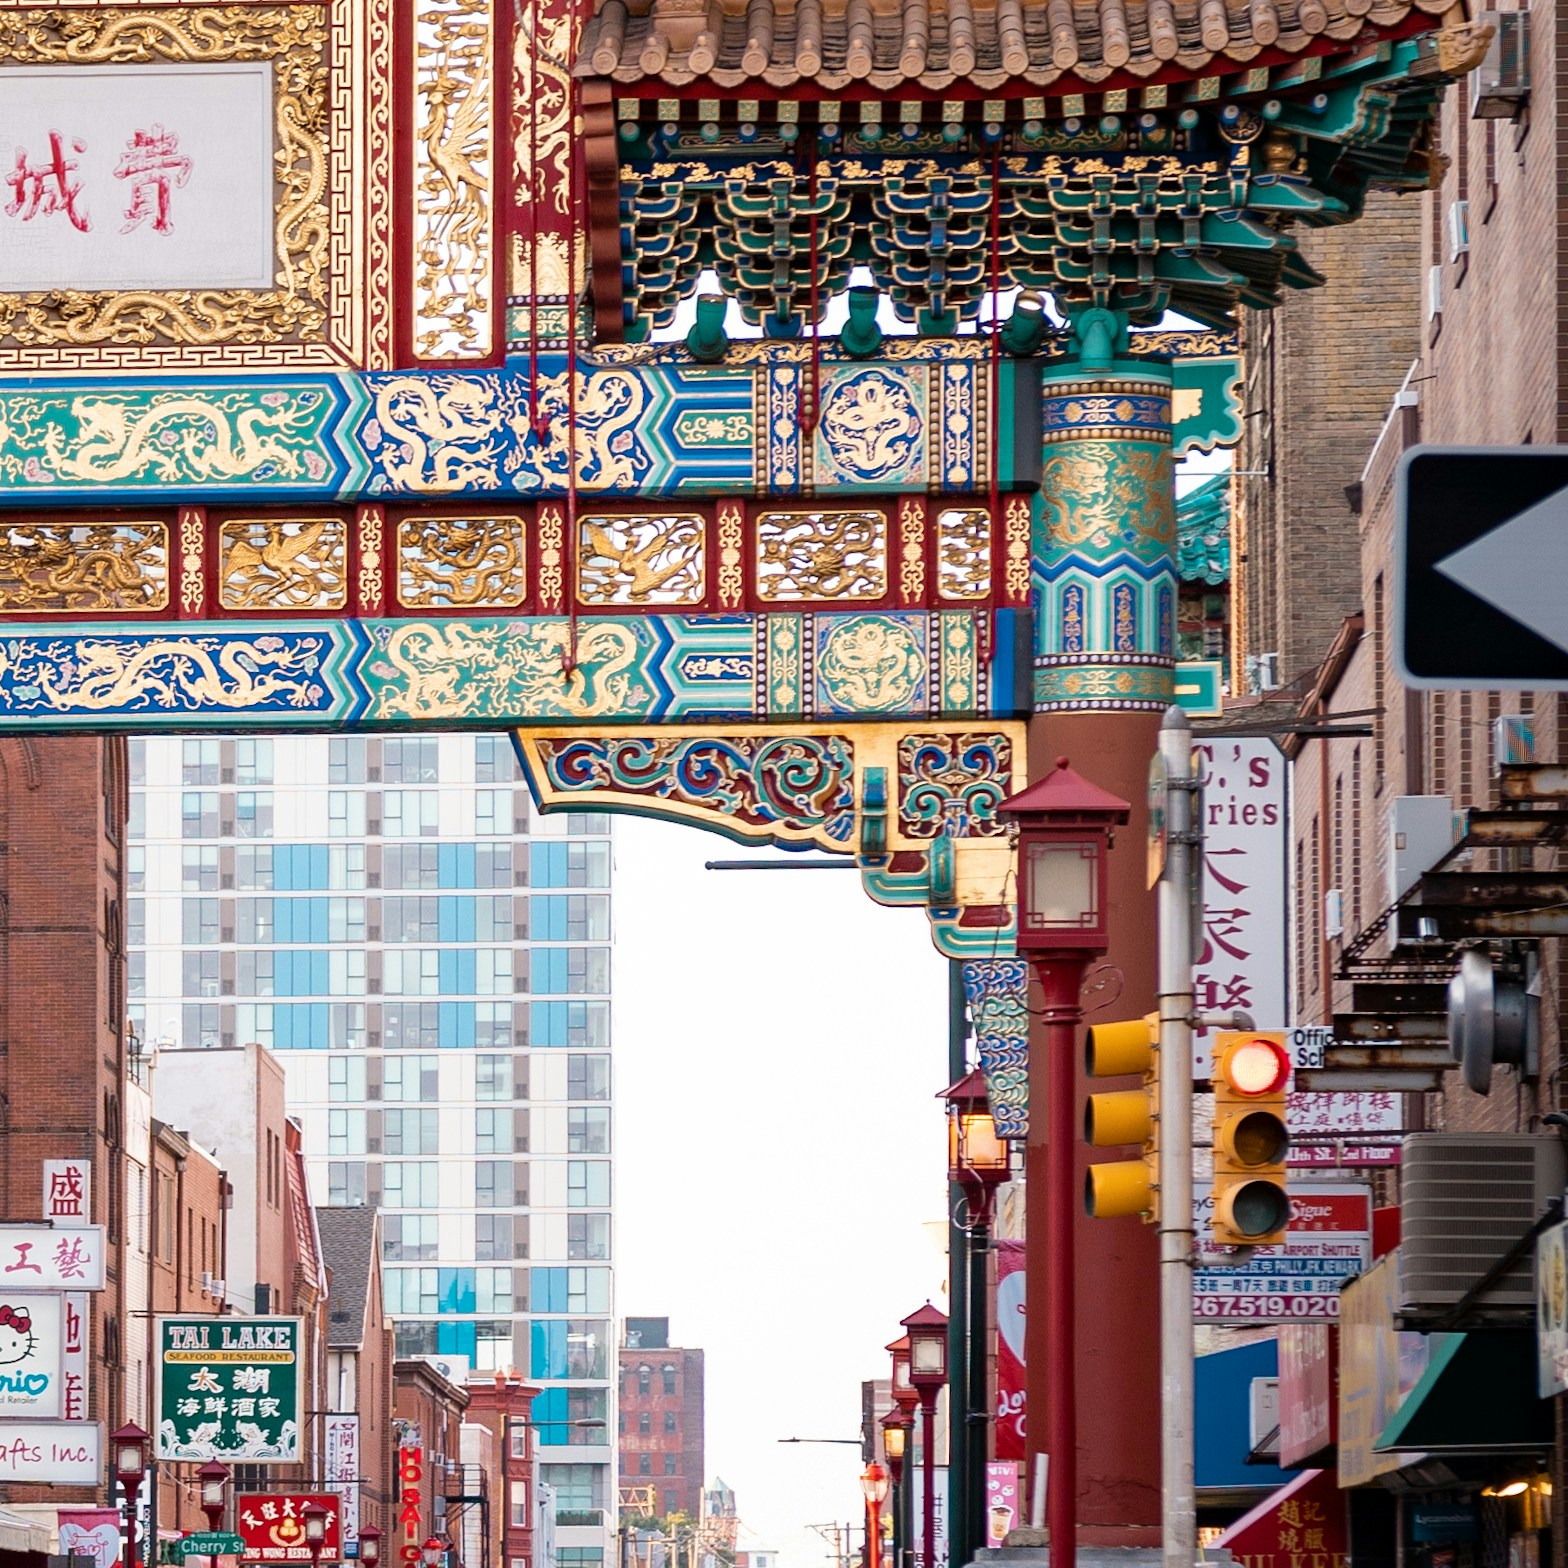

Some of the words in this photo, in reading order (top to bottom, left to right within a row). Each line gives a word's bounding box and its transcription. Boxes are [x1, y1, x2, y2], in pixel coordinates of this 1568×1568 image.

[48, 1166, 83, 1216] 盛
[1283, 1245, 1320, 1256] AIRPORT
[1322, 1243, 1361, 1257] SHUTTLE
[169, 1326, 210, 1349] TAI
[222, 1326, 291, 1349] LAKE
[169, 1352, 217, 1361] SEAFOOD
[222, 1352, 291, 1362] RESTAURANT
[8, 1394, 38, 1405] Retailer
[177, 1397, 281, 1419] 海鮮酒家
[52, 1443, 94, 1463] Inc.
[182, 1540, 226, 1554] Cherry
[233, 1542, 244, 1552] St
[287, 1548, 337, 1560] RESTAANT
